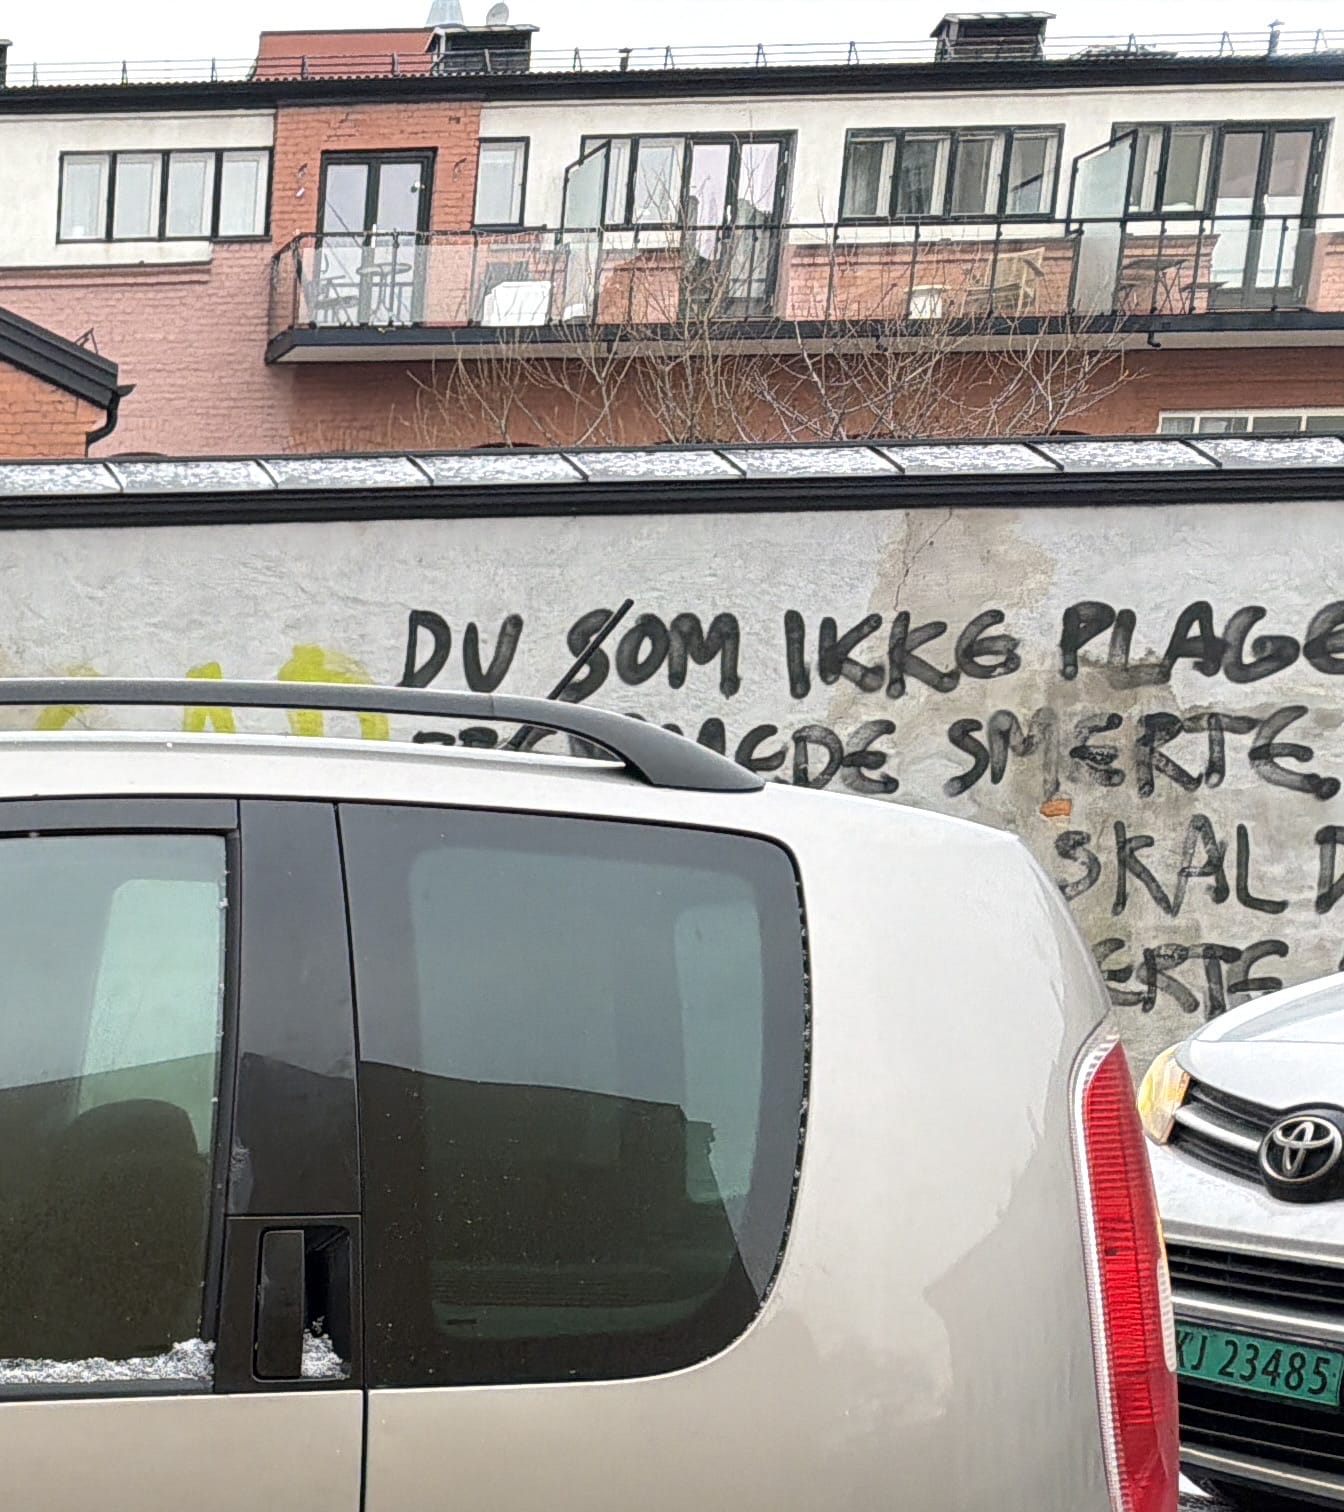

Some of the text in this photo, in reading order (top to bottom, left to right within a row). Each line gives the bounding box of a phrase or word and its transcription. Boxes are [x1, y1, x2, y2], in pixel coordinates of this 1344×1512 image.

[398, 600, 1344, 703] DU SOM IKKE PLAGE
[943, 704, 1342, 800] SMERTE
[1054, 813, 1289, 917] SKAL
[1218, 1339, 1331, 1395] 23485
